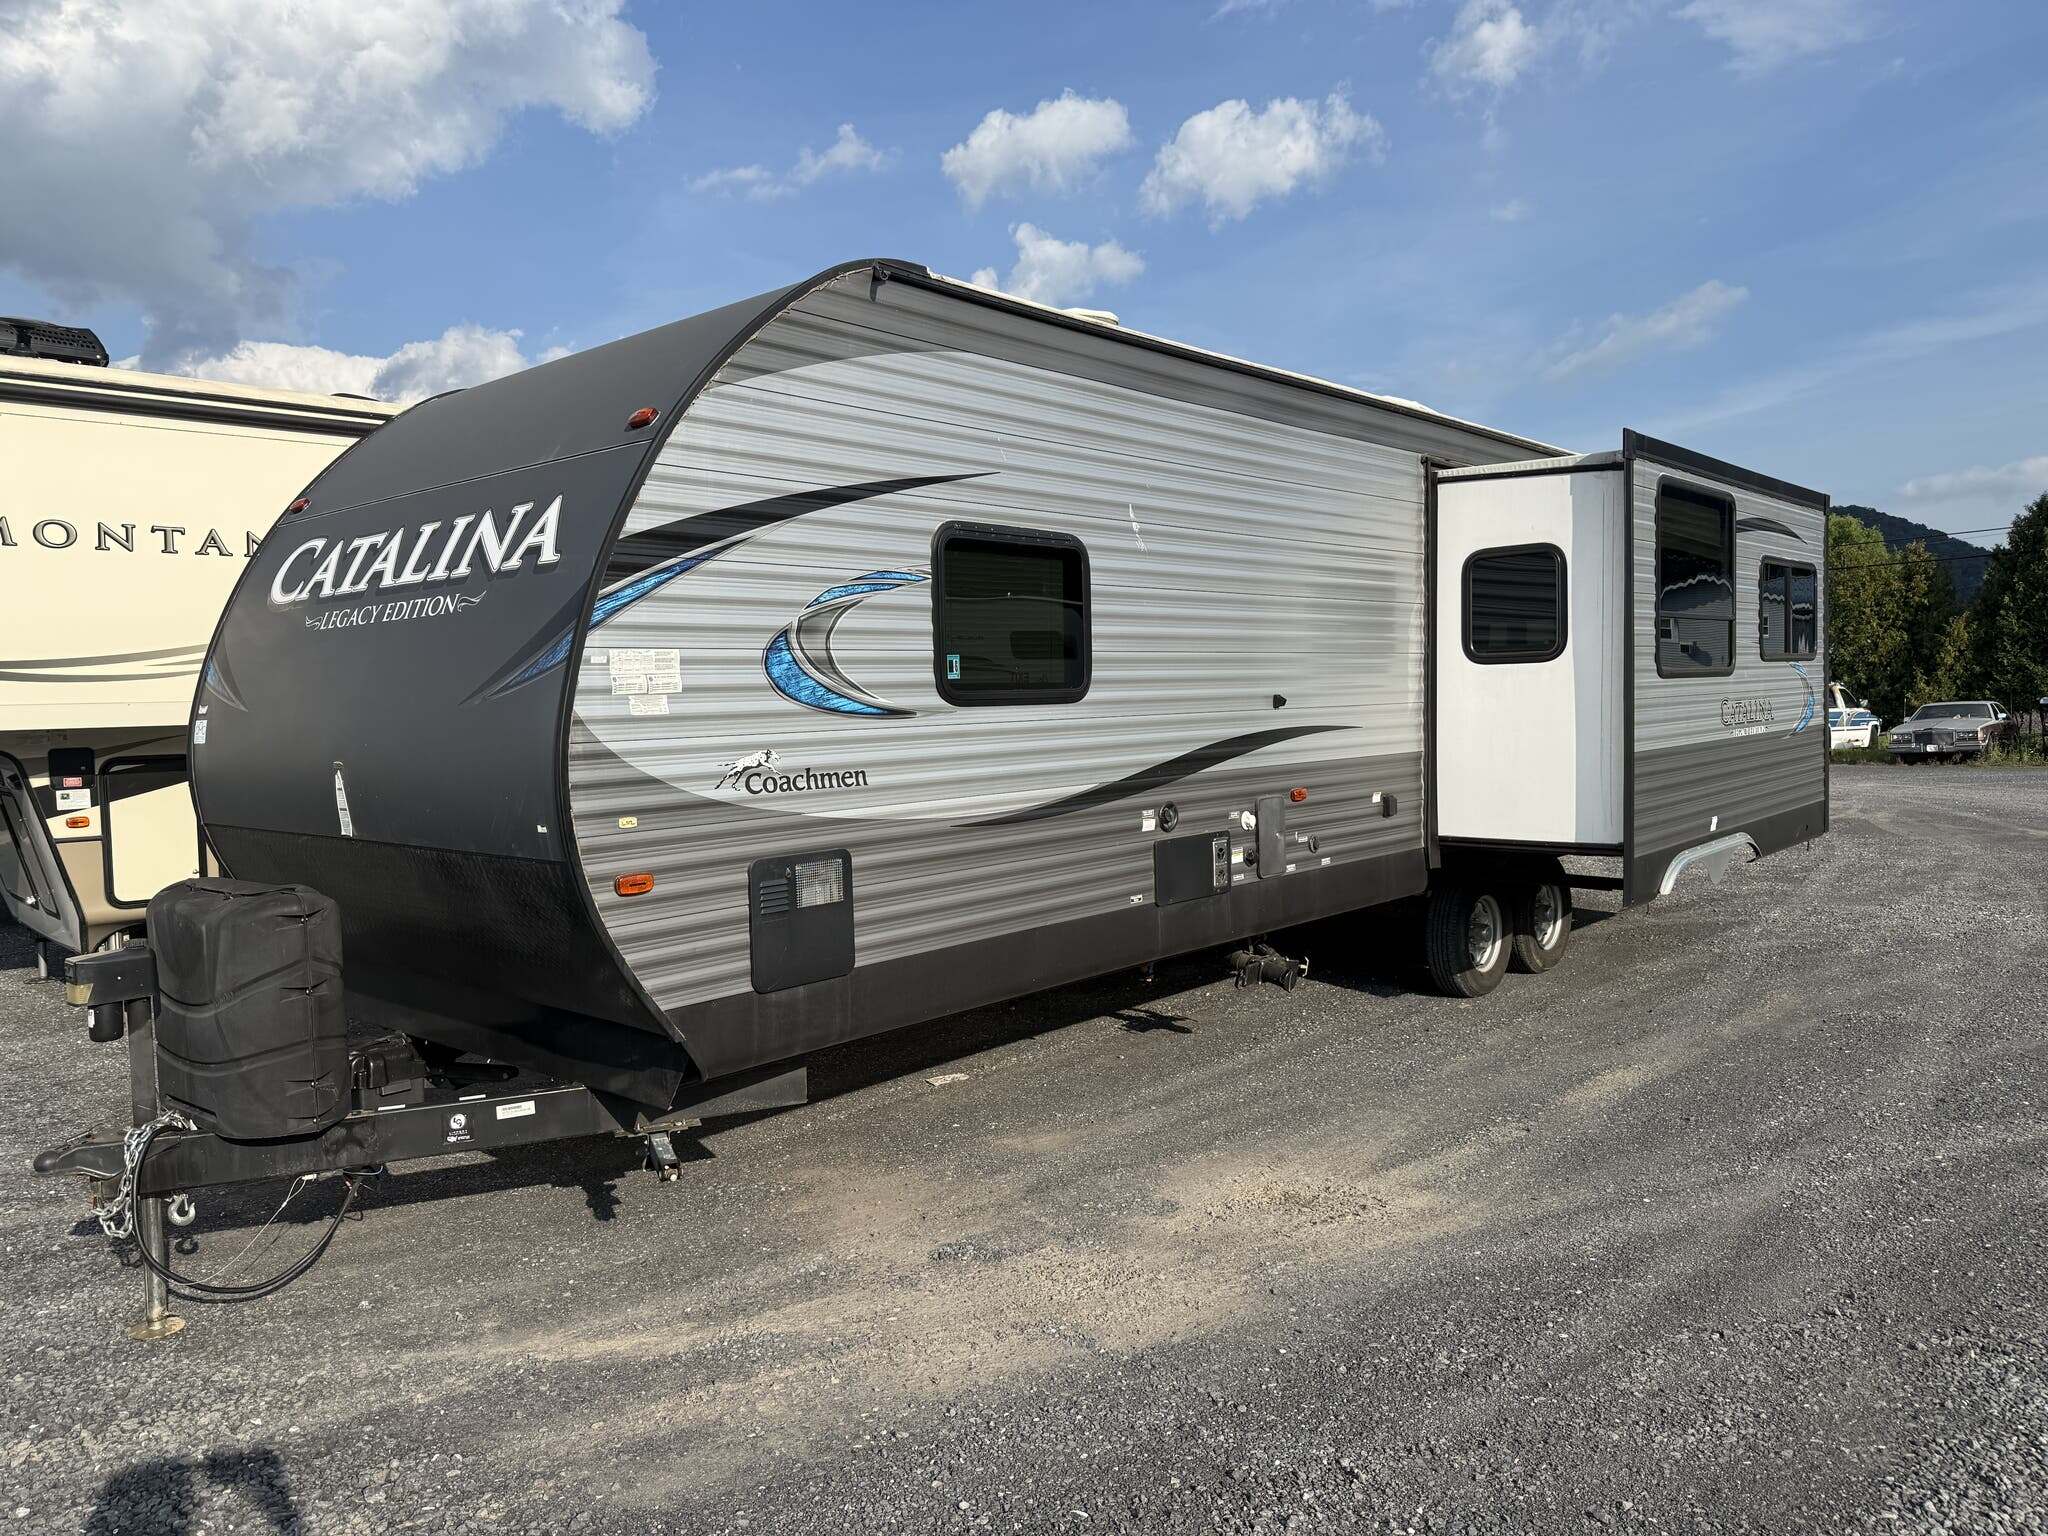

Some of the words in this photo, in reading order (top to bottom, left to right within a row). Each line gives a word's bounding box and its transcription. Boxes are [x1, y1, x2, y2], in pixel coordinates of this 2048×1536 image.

[269, 493, 564, 605] CATALINA
[320, 602, 385, 631] LEGACY
[383, 593, 461, 622] EDITION
[1720, 696, 1775, 727] CATALINA
[744, 767, 869, 795] Coachmen
